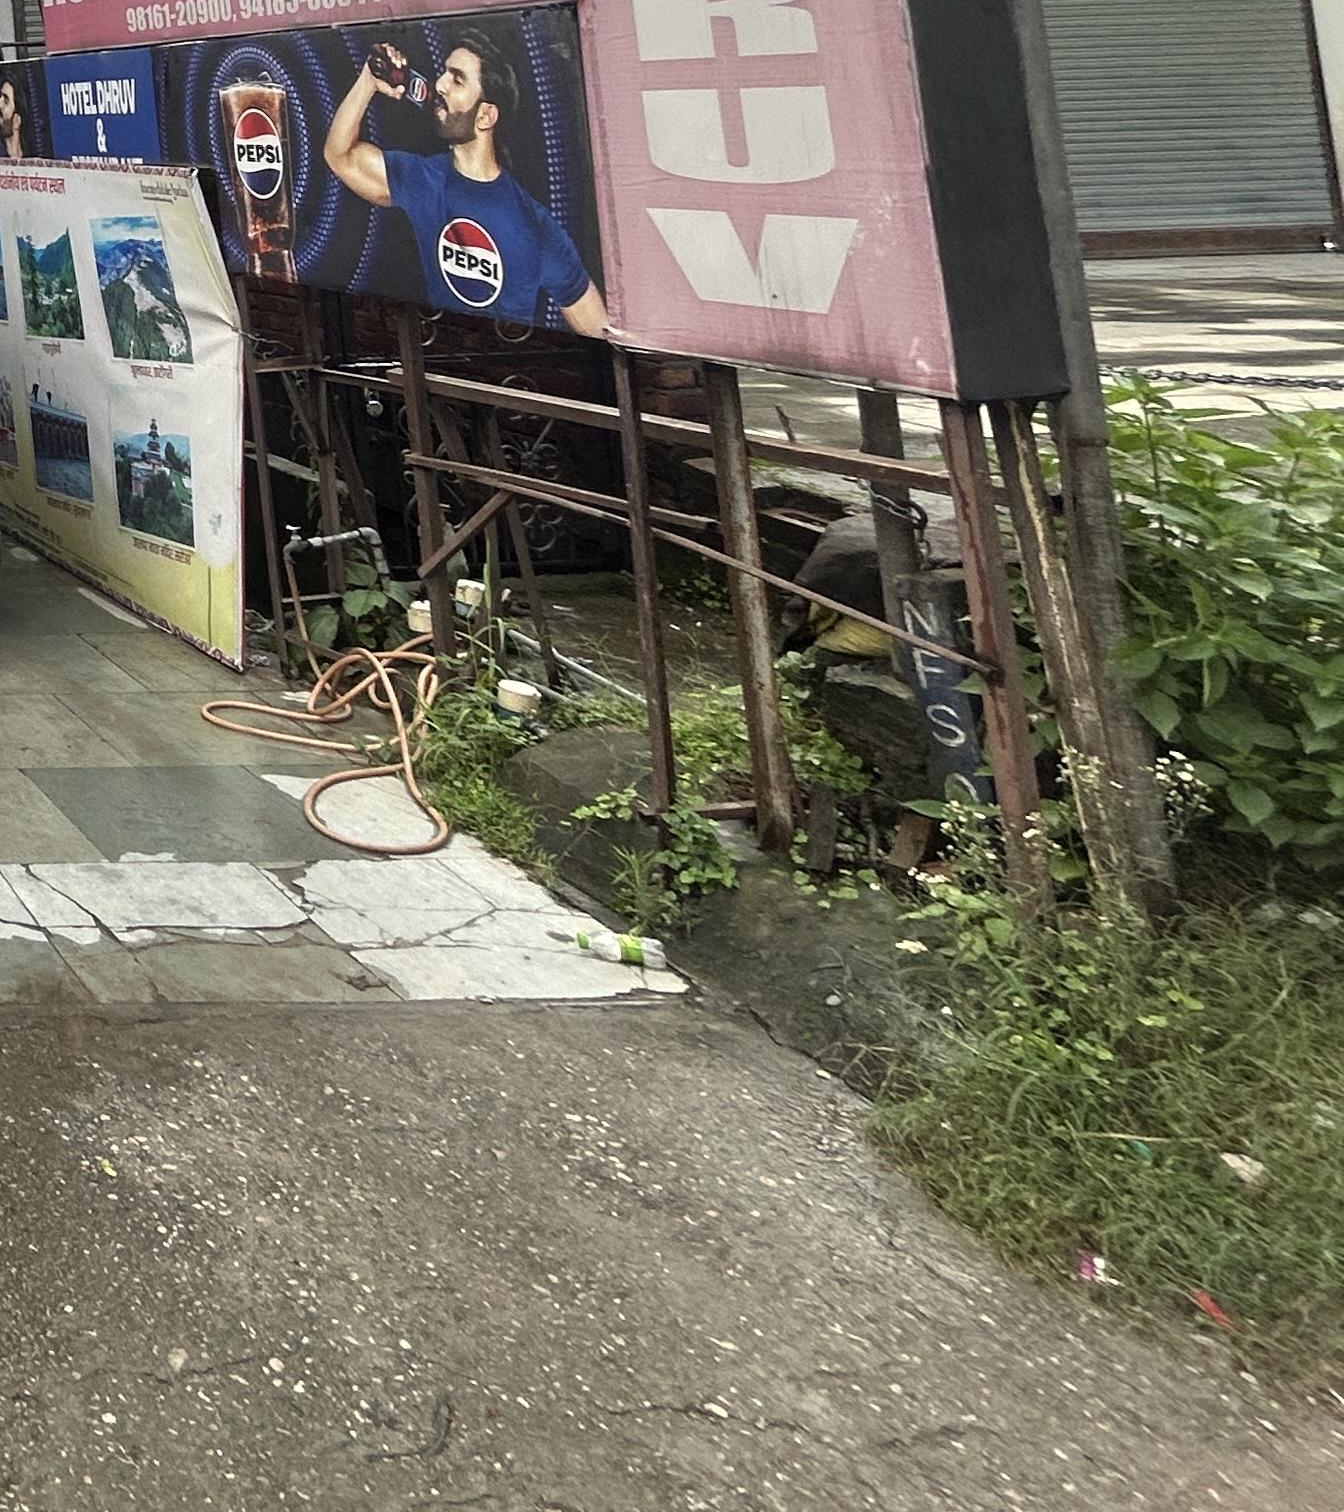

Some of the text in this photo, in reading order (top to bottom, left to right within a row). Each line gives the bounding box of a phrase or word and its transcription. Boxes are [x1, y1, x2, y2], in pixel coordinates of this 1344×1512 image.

[60, 79, 136, 116] HOTEL DHRUV
[96, 118, 108, 153] &
[236, 142, 283, 164] PEPSI
[442, 245, 499, 281] PEPSI
